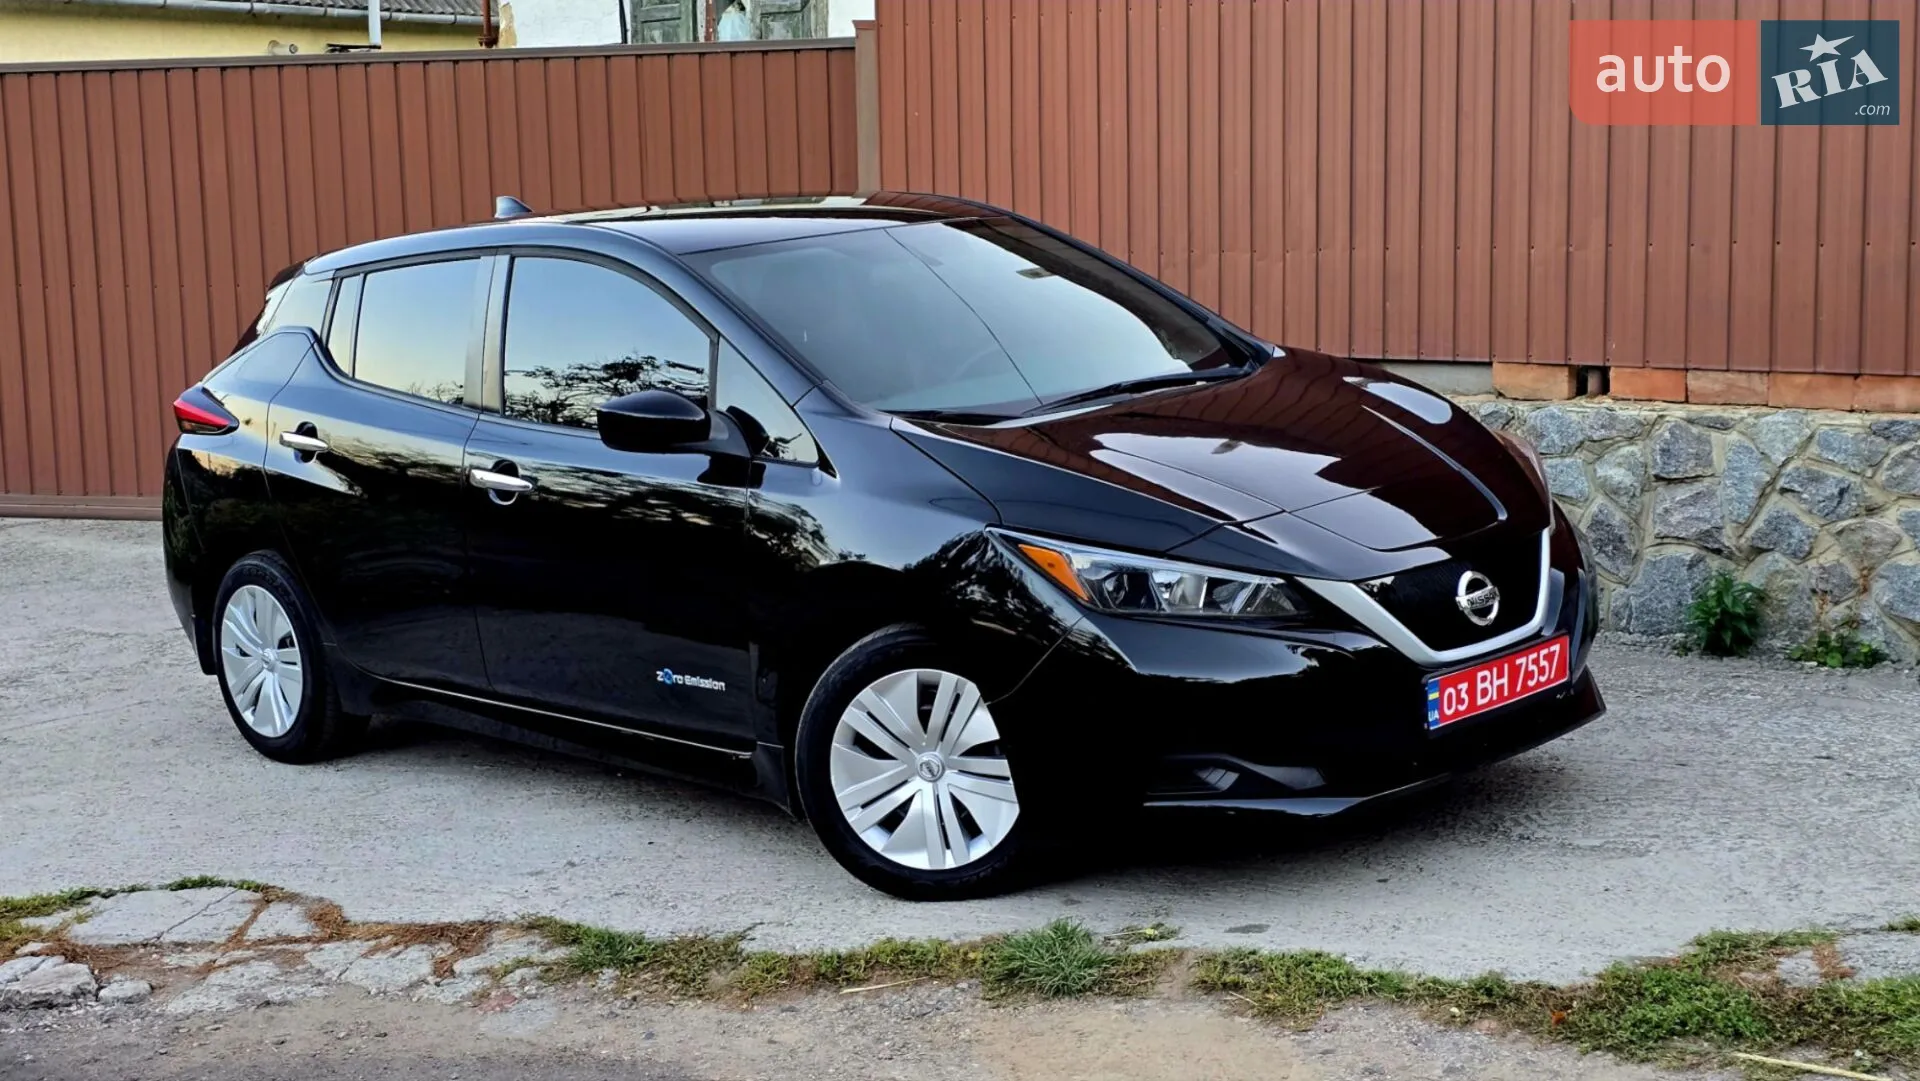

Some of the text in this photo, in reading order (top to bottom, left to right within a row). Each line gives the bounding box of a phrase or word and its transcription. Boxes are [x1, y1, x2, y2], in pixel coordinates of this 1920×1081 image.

[685, 675, 726, 691] Emission
[1443, 643, 1560, 716] 03 BH 7557
[1428, 709, 1440, 722] UA
